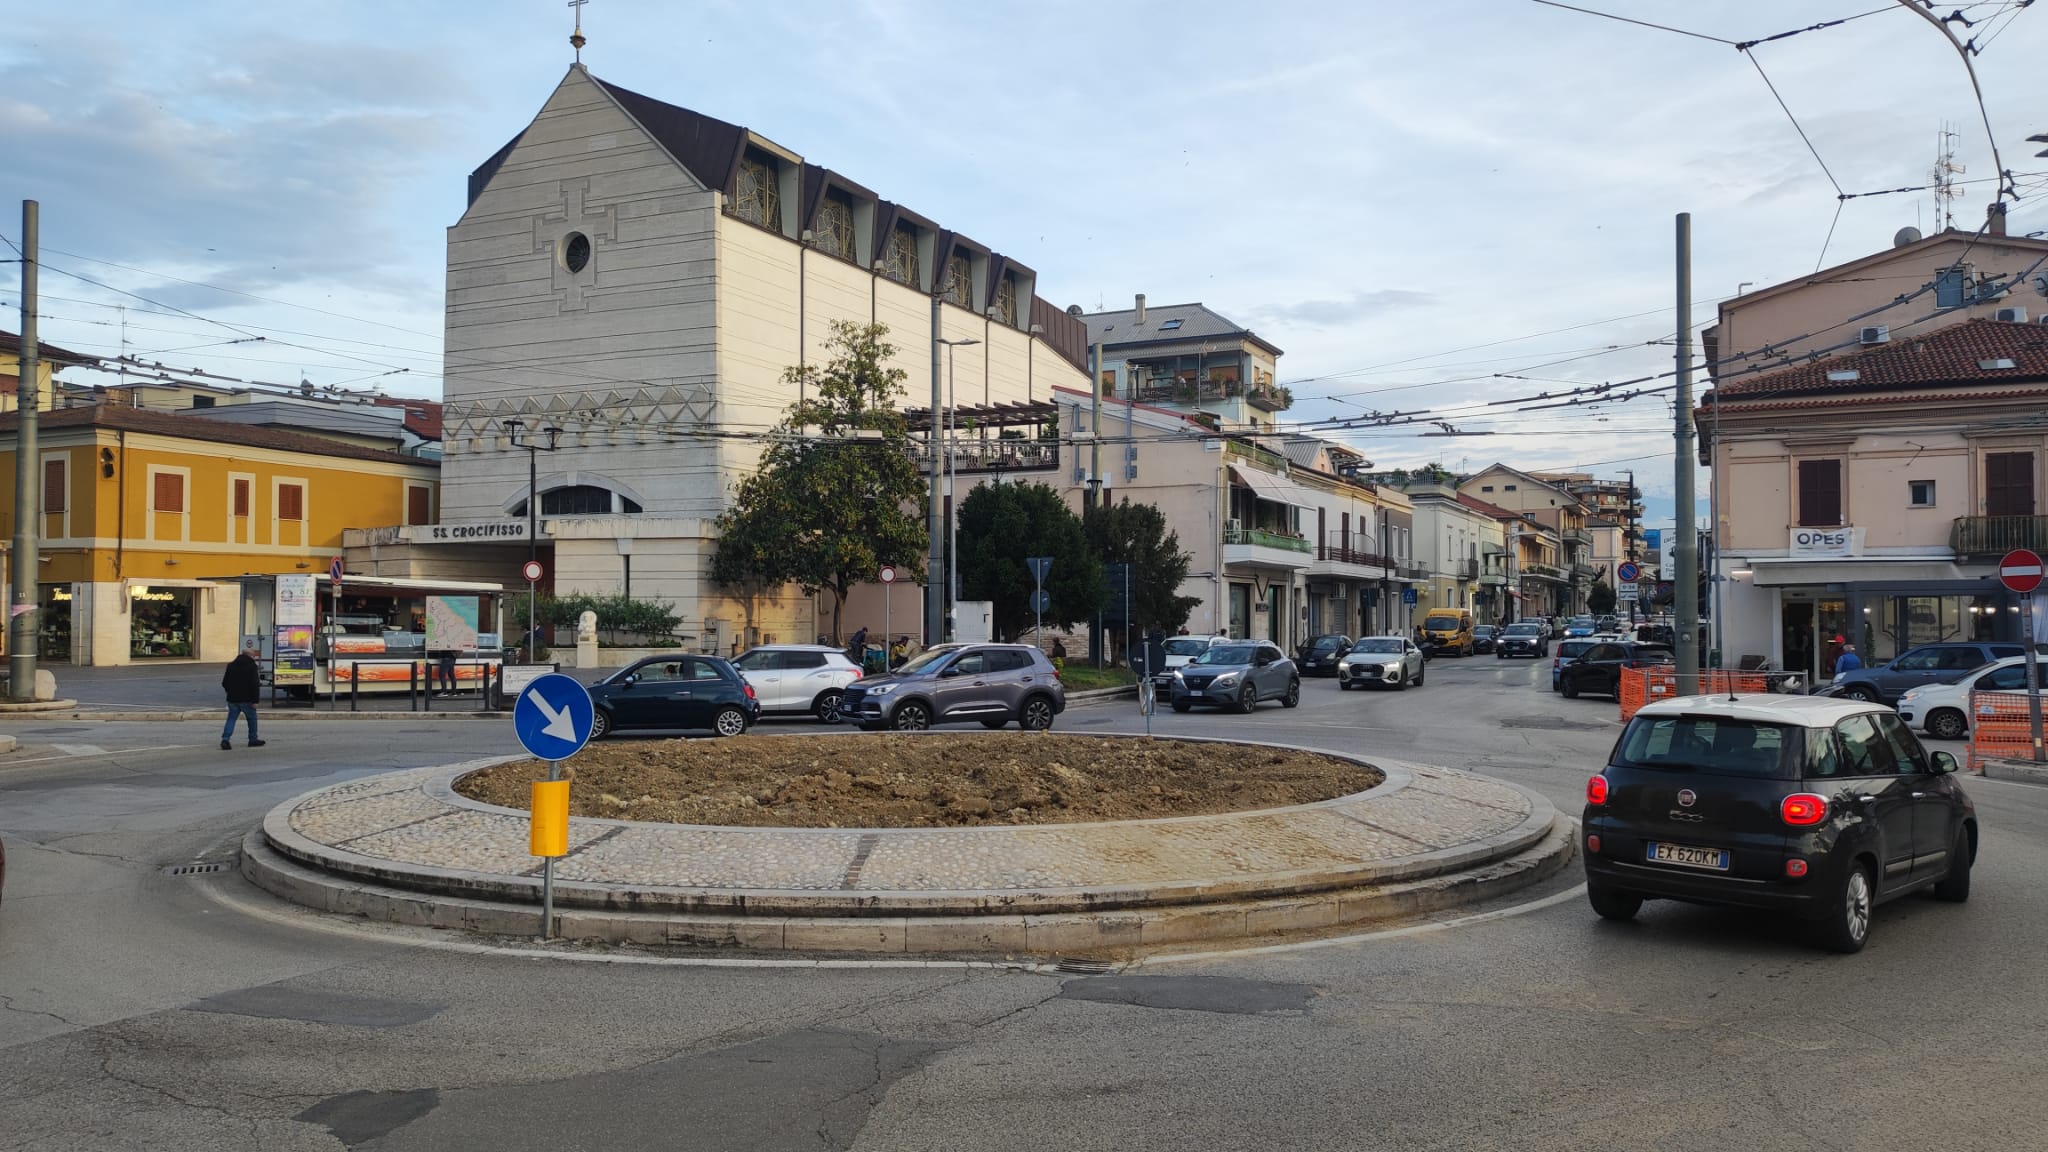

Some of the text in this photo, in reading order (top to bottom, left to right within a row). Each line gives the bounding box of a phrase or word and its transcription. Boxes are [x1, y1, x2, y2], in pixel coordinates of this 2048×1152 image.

[452, 524, 523, 538] CROCIFISSO
[1797, 533, 1845, 545] OPES
[1657, 846, 1719, 865] EX 620KM
